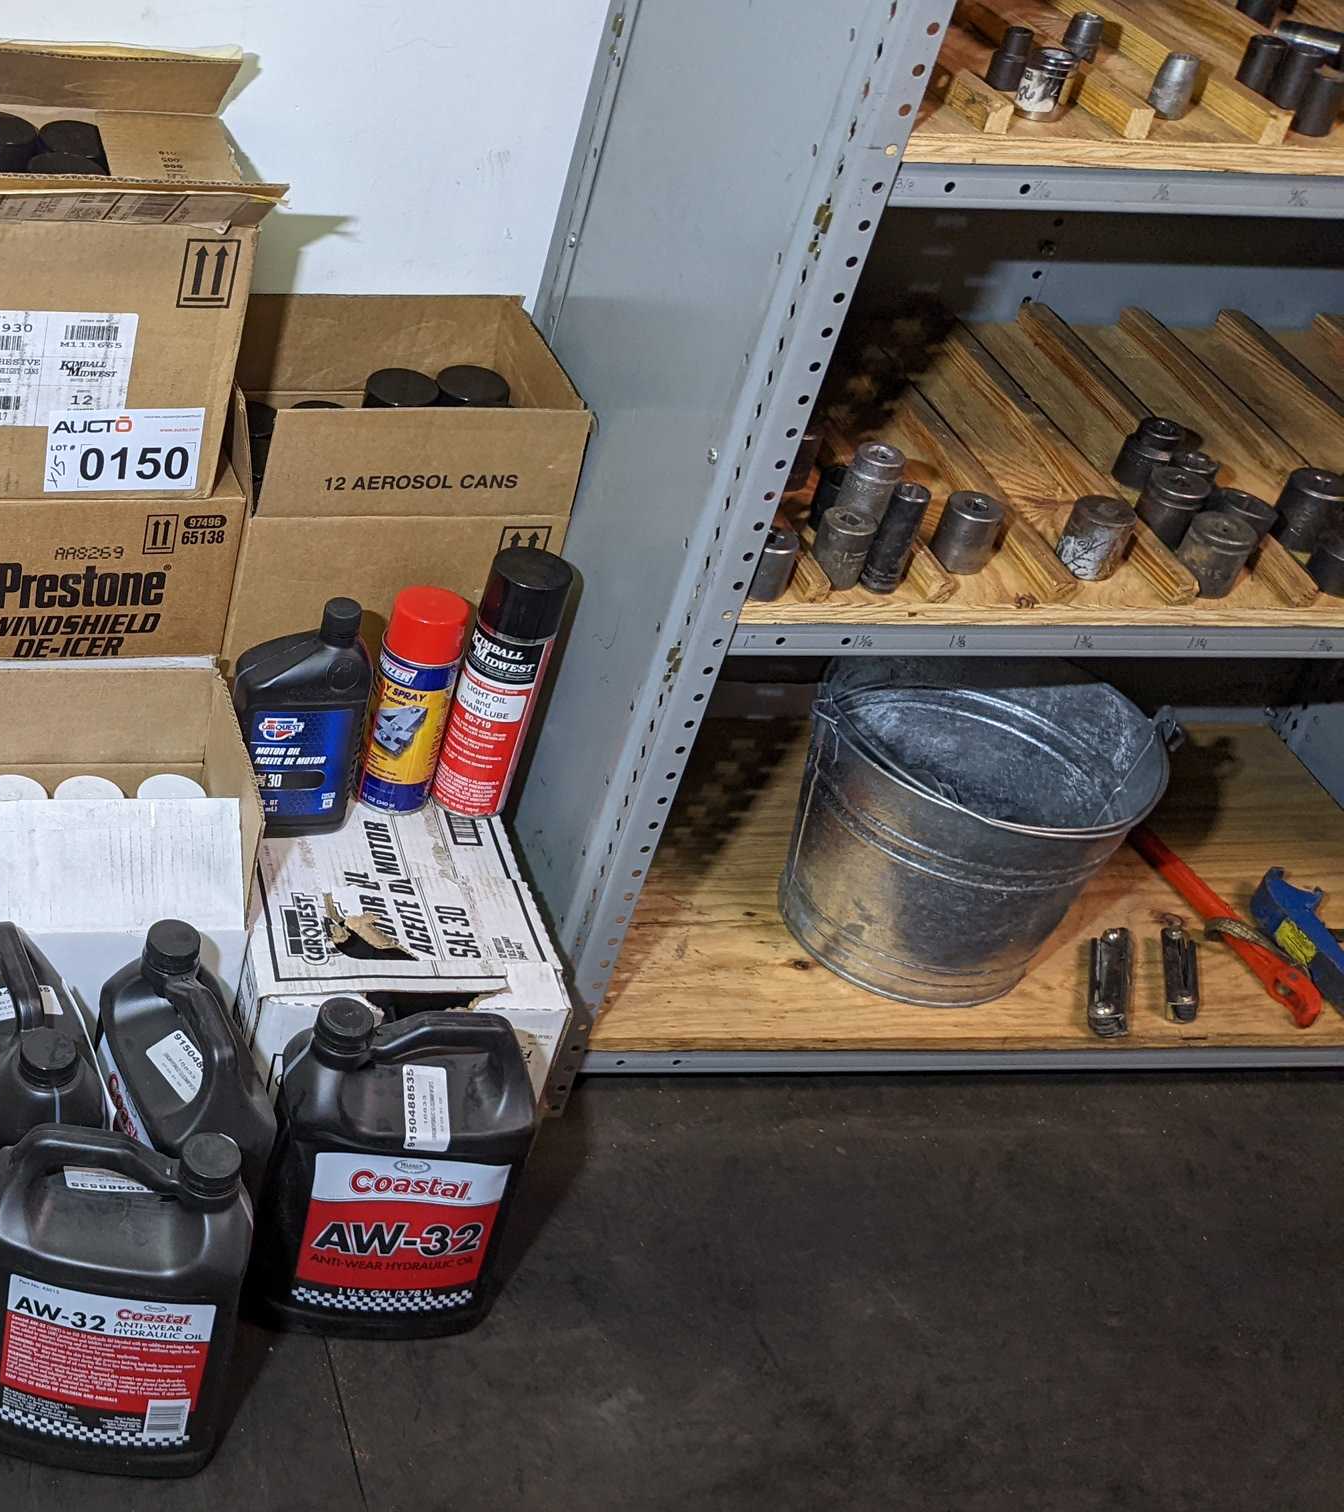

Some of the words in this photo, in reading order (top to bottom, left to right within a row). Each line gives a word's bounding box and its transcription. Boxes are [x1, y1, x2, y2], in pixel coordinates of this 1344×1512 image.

[59, 360, 107, 371] KIMBALL
[67, 367, 117, 378] MIDWEST
[70, 395, 93, 405] 12
[79, 446, 189, 481] 0150
[325, 476, 347, 491] 12
[352, 475, 453, 490] AEROSOL
[459, 473, 518, 489] CANS
[189, 517, 221, 527] 97496
[181, 530, 225, 545] 65138
[14, 637, 124, 658] DE-ICER
[472, 628, 524, 661] KIMBALL
[474, 644, 536, 673] MIDWEST
[392, 687, 427, 702] SPRAY
[467, 683, 490, 700] LIGHT
[492, 694, 508, 705] OIL
[460, 694, 482, 714] CHAIN
[484, 709, 510, 720] LUBE
[475, 697, 492, 709] and
[260, 721, 304, 732] CARQUEST
[256, 747, 285, 755] MOTOR
[287, 747, 301, 755] OIL
[254, 756, 283, 765] ACEITE
[284, 757, 295, 765] DE
[296, 756, 327, 765] MOTOR
[267, 774, 282, 787] 30
[364, 820, 402, 877] MOTOR
[435, 905, 473, 927] 30
[299, 893, 325, 961] CARQUEST
[394, 899, 435, 957] ACEITE
[442, 928, 483, 959] SAE
[406, 1068, 416, 1149] 9150488535
[349, 1168, 472, 1200] Coastal
[313, 1222, 484, 1256] AW-32
[310, 1253, 382, 1270] ANTI-WEAR
[385, 1260, 453, 1270] HYDRAULIC
[457, 1256, 473, 1265] OIL
[346, 1288, 367, 1296] U.S.
[370, 1289, 392, 1297] GAL
[15, 1296, 106, 1331] AW-32
[115, 1308, 192, 1325] Coastal
[113, 1327, 181, 1340] HYDRAULIC
[114, 1321, 183, 1333] ANTI-WEAR
